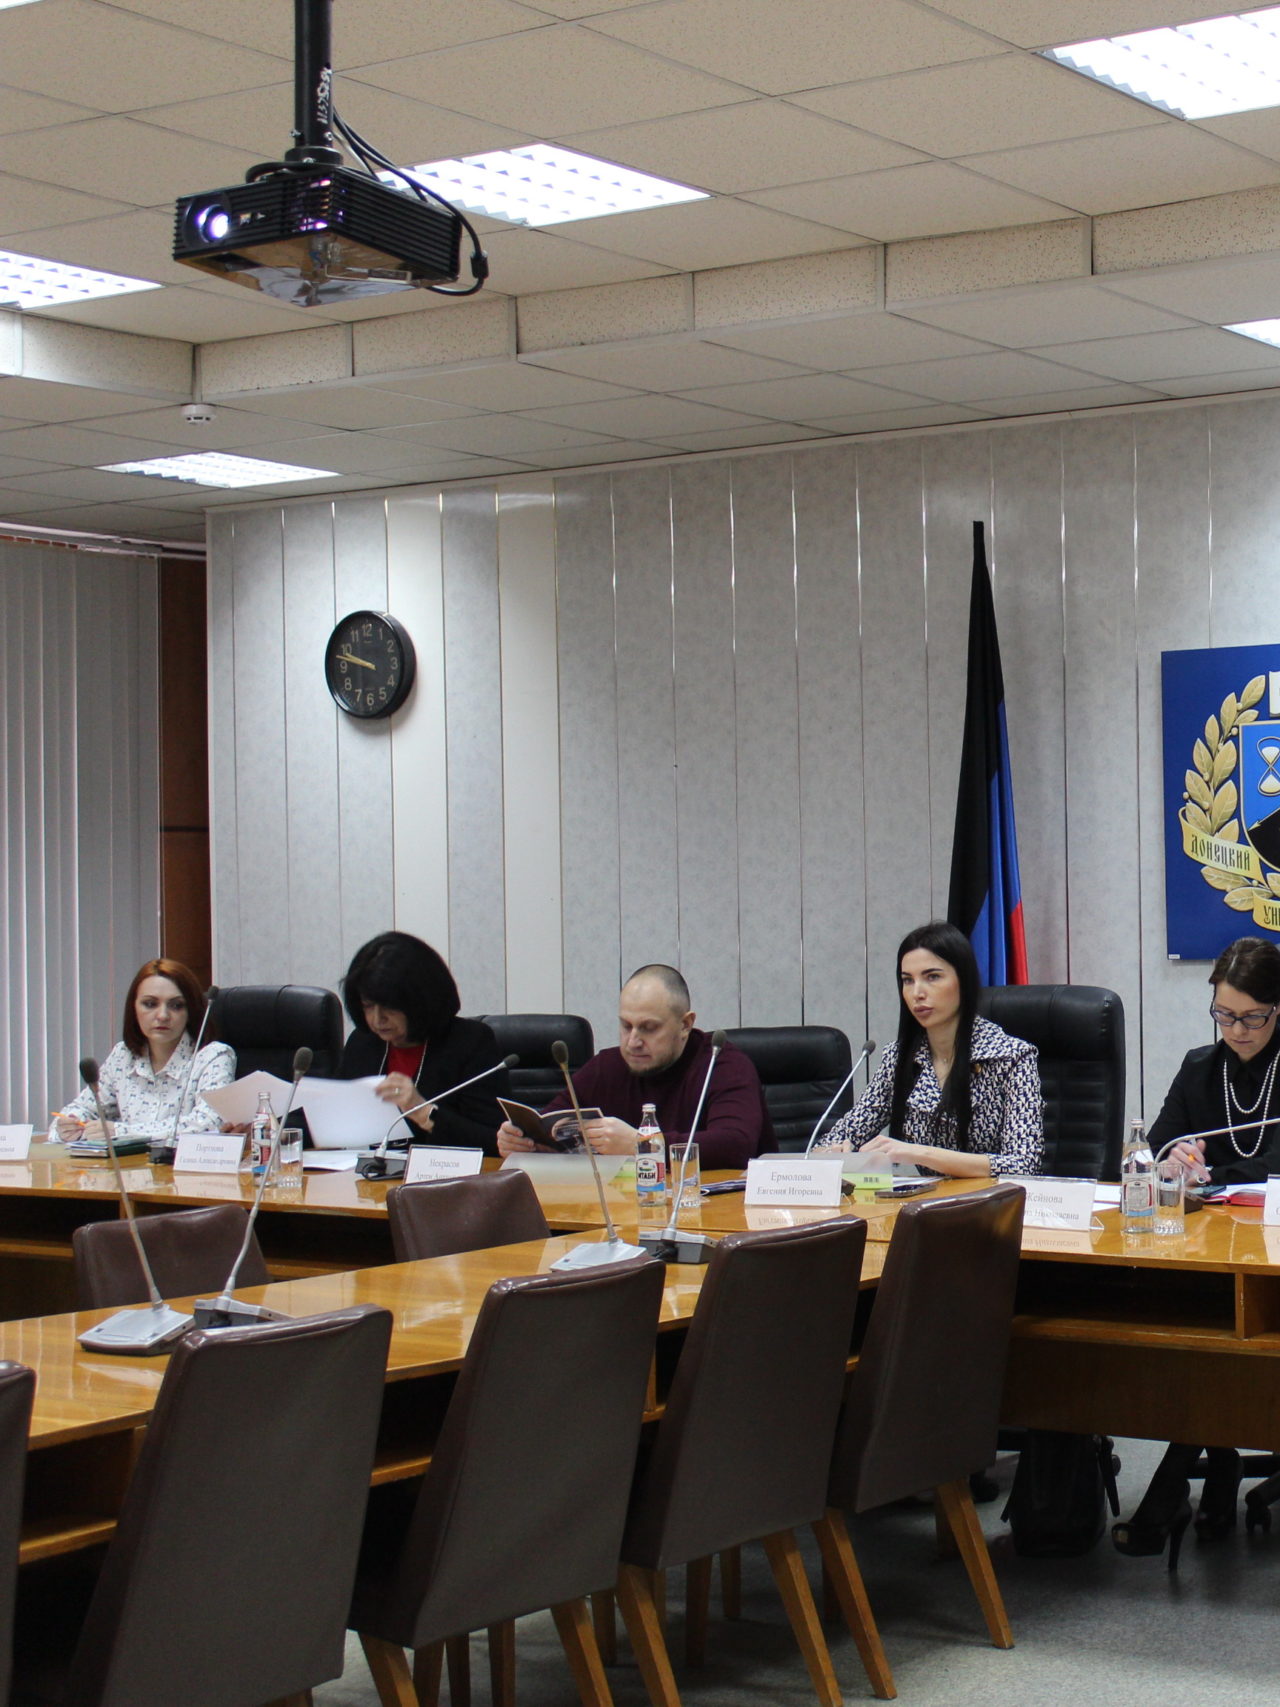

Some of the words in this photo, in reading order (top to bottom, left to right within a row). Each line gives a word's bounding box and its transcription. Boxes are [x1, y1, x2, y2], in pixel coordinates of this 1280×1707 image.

[350, 629, 359, 643] 11
[362, 624, 373, 637] 12
[341, 643, 352, 655] 10
[387, 640, 395, 653] 2
[340, 661, 348, 673] 9
[391, 658, 398, 670] 3
[344, 677, 352, 690] 8
[387, 675, 395, 687] 4
[355, 689, 362, 702] 7
[366, 693, 374, 706] 6
[379, 688, 387, 700] 5
[771, 1172, 812, 1182] Ермолова
